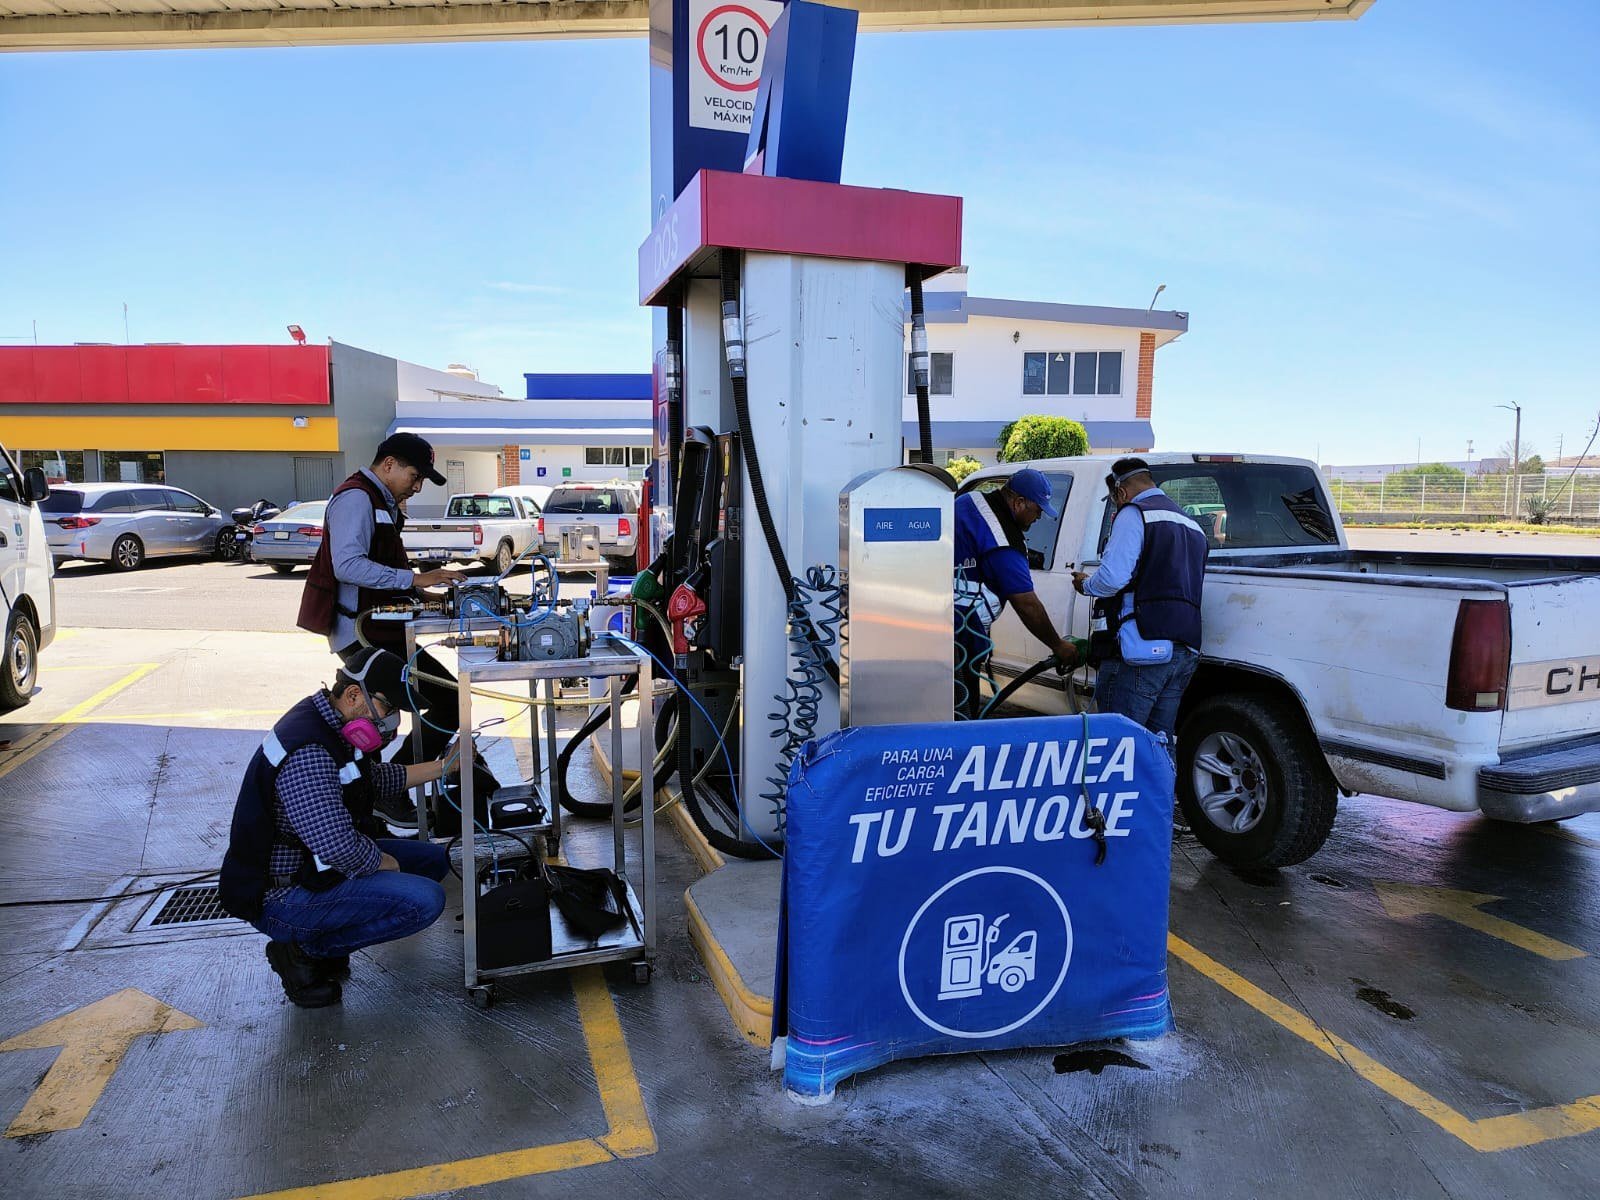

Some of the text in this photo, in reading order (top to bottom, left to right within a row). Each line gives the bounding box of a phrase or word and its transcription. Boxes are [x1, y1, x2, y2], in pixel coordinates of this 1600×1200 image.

[714, 24, 759, 64] 10
[720, 63, 753, 77] Km/Hr
[704, 95, 756, 111] VELOCID
[713, 109, 752, 125] MÁXIM
[876, 521, 931, 530] AIRE AGUA
[881, 747, 953, 765] PARA UNA
[897, 765, 945, 781] CARGA
[947, 737, 1135, 794] ALINEA
[865, 783, 935, 802] EFICIENTE
[849, 792, 1139, 864] TU TANQUE
